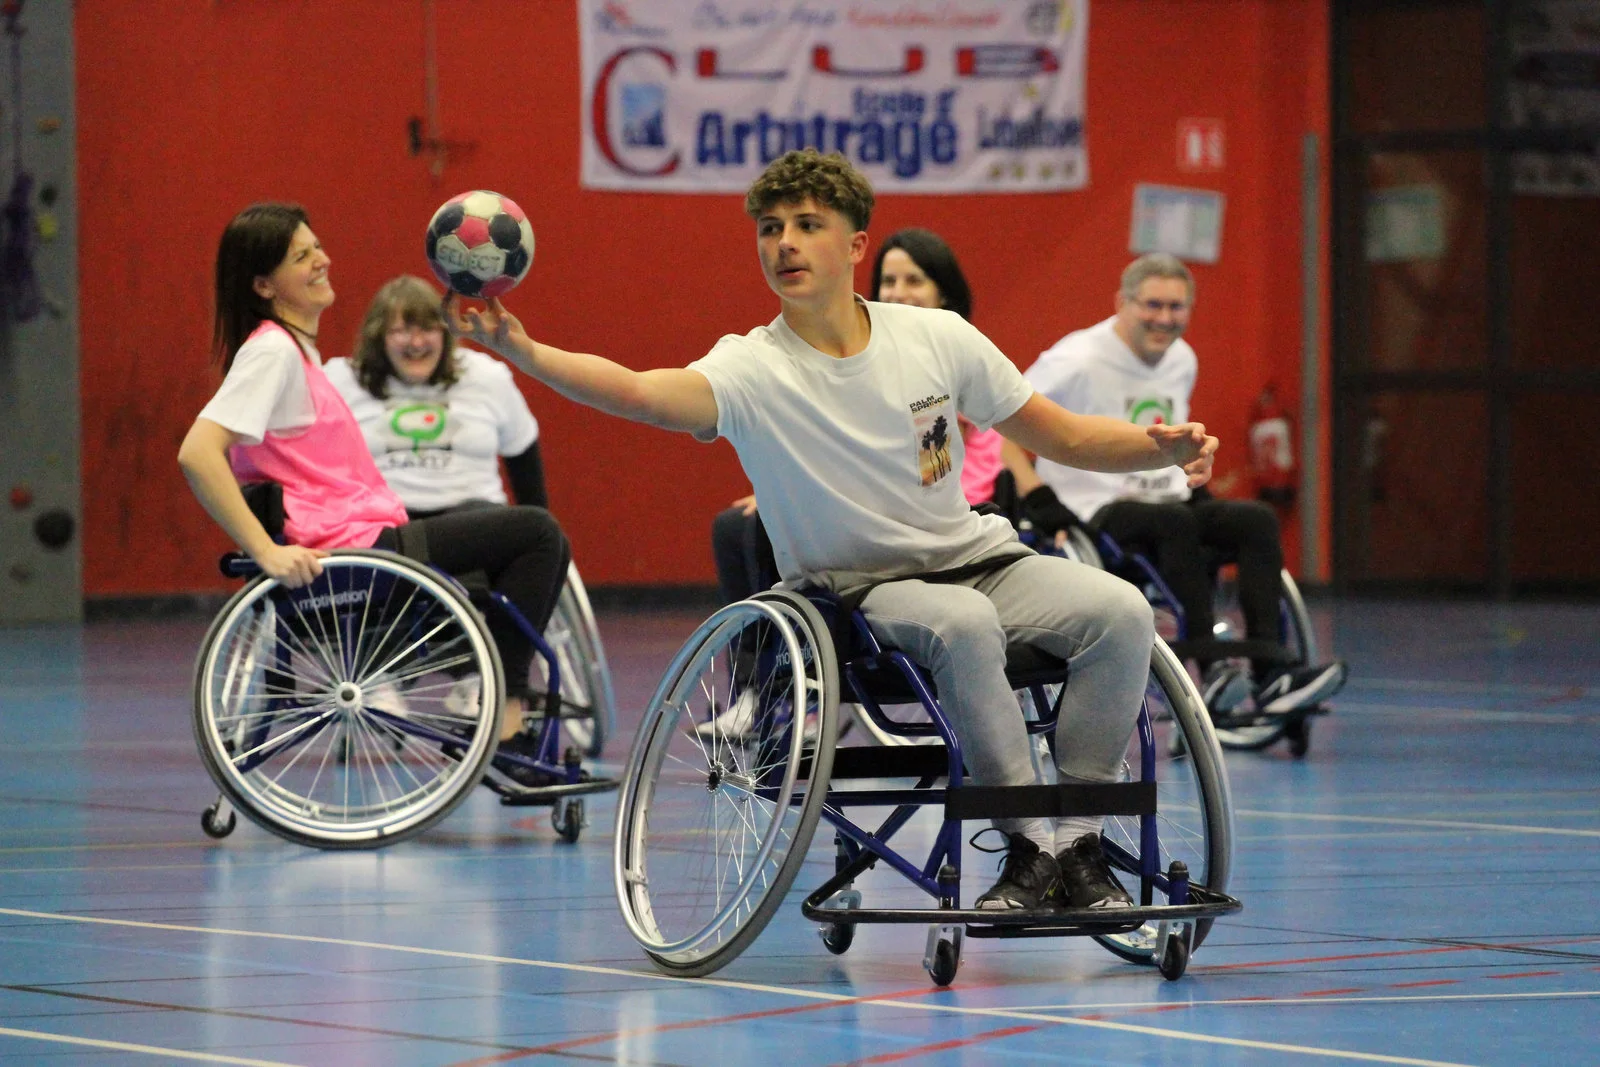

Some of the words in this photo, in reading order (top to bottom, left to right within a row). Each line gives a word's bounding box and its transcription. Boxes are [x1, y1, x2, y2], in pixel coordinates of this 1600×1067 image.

[437, 243, 502, 274] SELECT
[909, 396, 935, 409] PALM
[911, 395, 950, 414] SPRINGS
[299, 588, 368, 611] motivation
